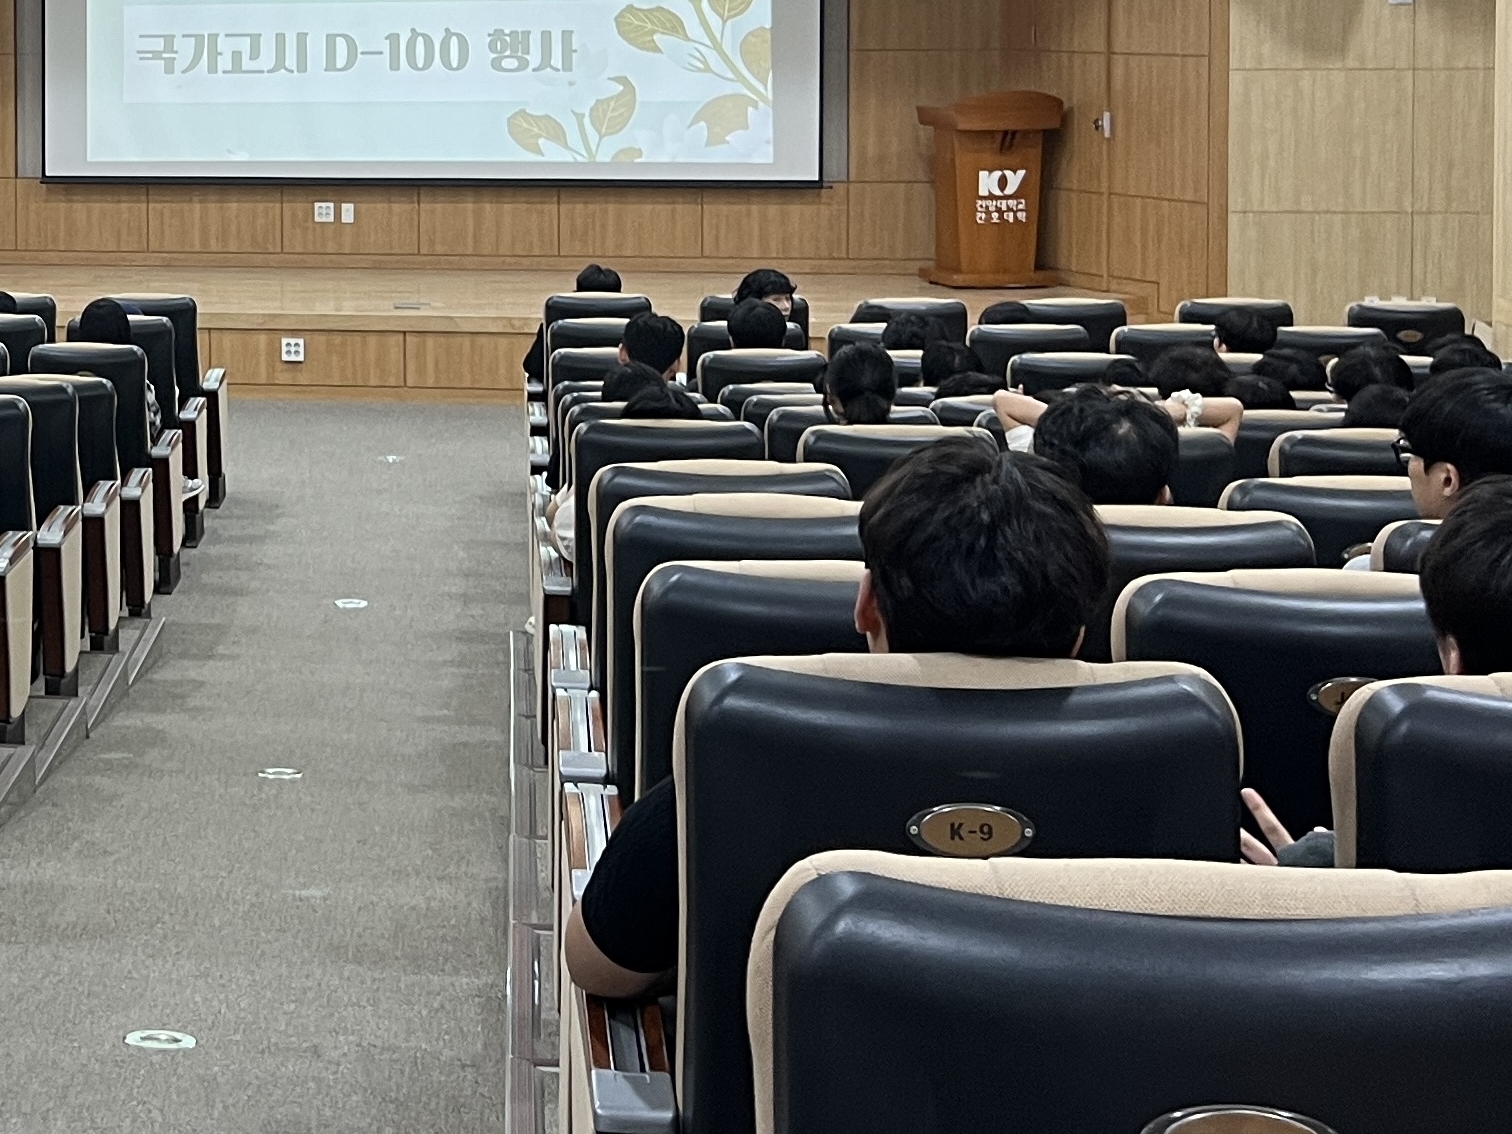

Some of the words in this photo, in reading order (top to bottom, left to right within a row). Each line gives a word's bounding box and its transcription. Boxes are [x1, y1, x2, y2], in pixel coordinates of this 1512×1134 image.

[136, 31, 309, 75] 국가고시
[323, 27, 470, 72] D-100
[487, 28, 578, 73] 행사
[949, 822, 994, 841] K-9
